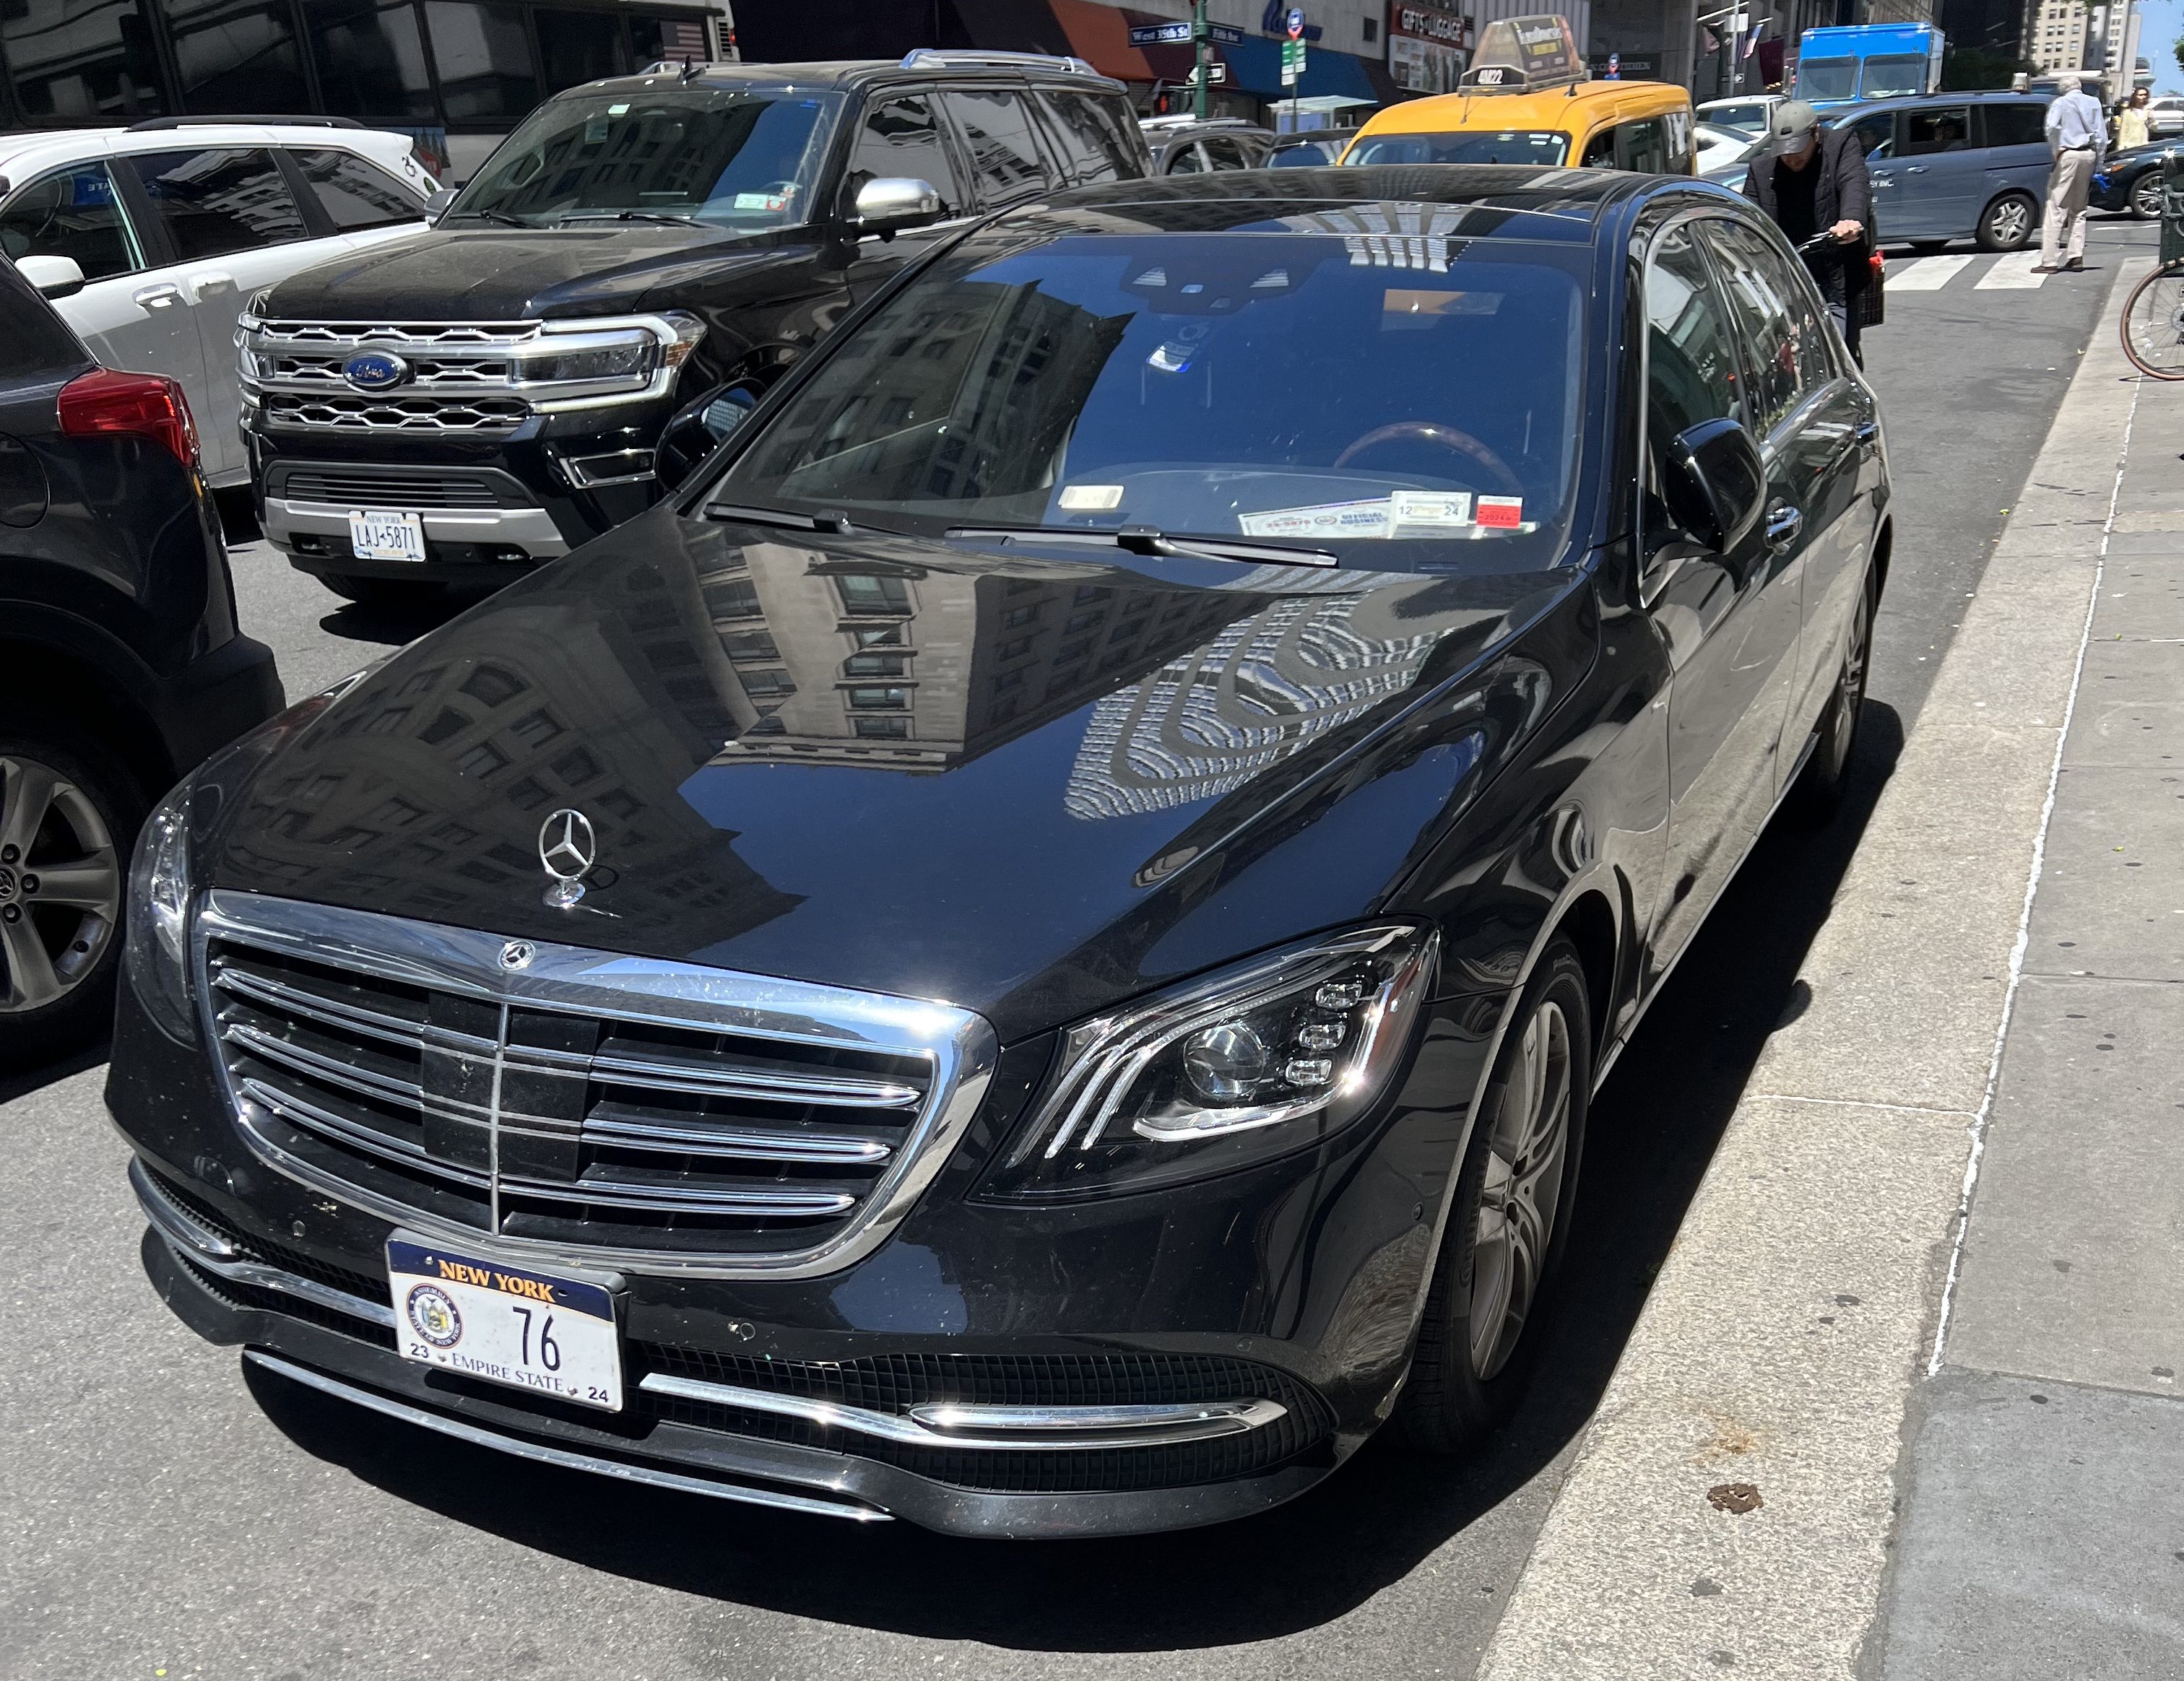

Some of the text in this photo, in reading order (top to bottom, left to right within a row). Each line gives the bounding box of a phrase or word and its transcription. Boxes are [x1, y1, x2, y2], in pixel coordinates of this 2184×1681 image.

[1132, 31, 1156, 41] West
[1177, 27, 1188, 38] St
[1399, 506, 1459, 516] 12 24
[384, 516, 402, 524] YORK
[437, 1259, 557, 1303] NEW YORK
[414, 1287, 453, 1304] ASSEMBLY
[513, 1306, 560, 1371] 76
[410, 1342, 429, 1358] 23
[452, 1352, 563, 1393] EMPIRE STATE
[588, 1386, 610, 1403] 24
